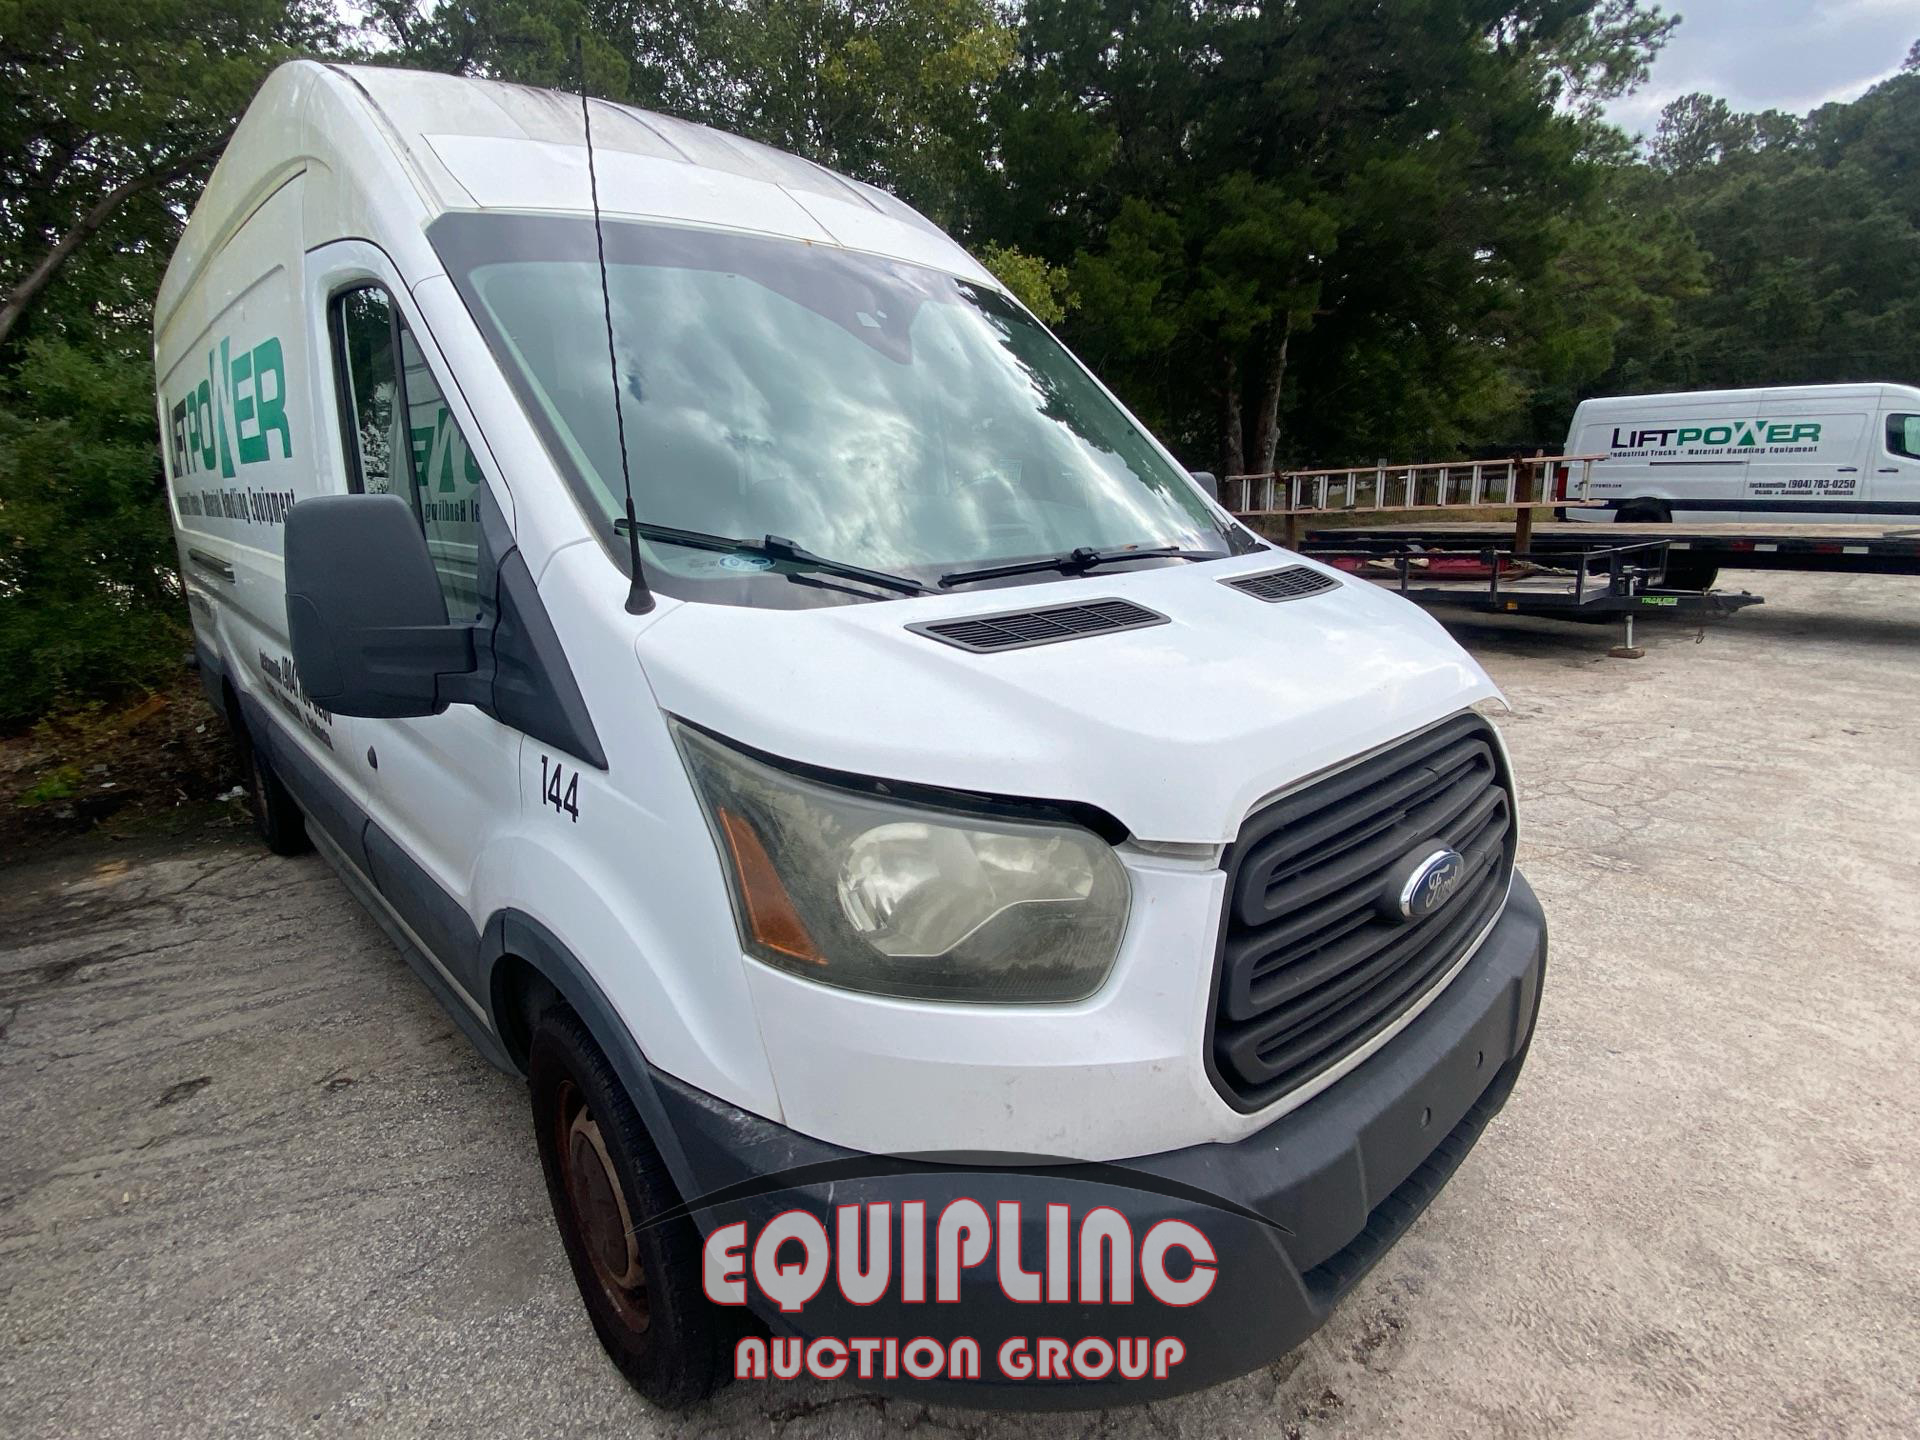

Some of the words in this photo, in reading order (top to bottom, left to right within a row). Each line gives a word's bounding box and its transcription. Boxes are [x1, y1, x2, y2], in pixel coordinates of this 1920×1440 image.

[1611, 421, 1822, 449] LIFTPOWER
[1650, 448, 1677, 456] Trucks
[1687, 447, 1723, 456] Material
[1726, 446, 1766, 455] Handling
[1769, 445, 1818, 454] Equipment
[1788, 480, 1812, 489] (904)
[1813, 480, 1856, 489] 783-0250
[541, 754, 579, 824] 144
[1425, 863, 1457, 909] Ford
